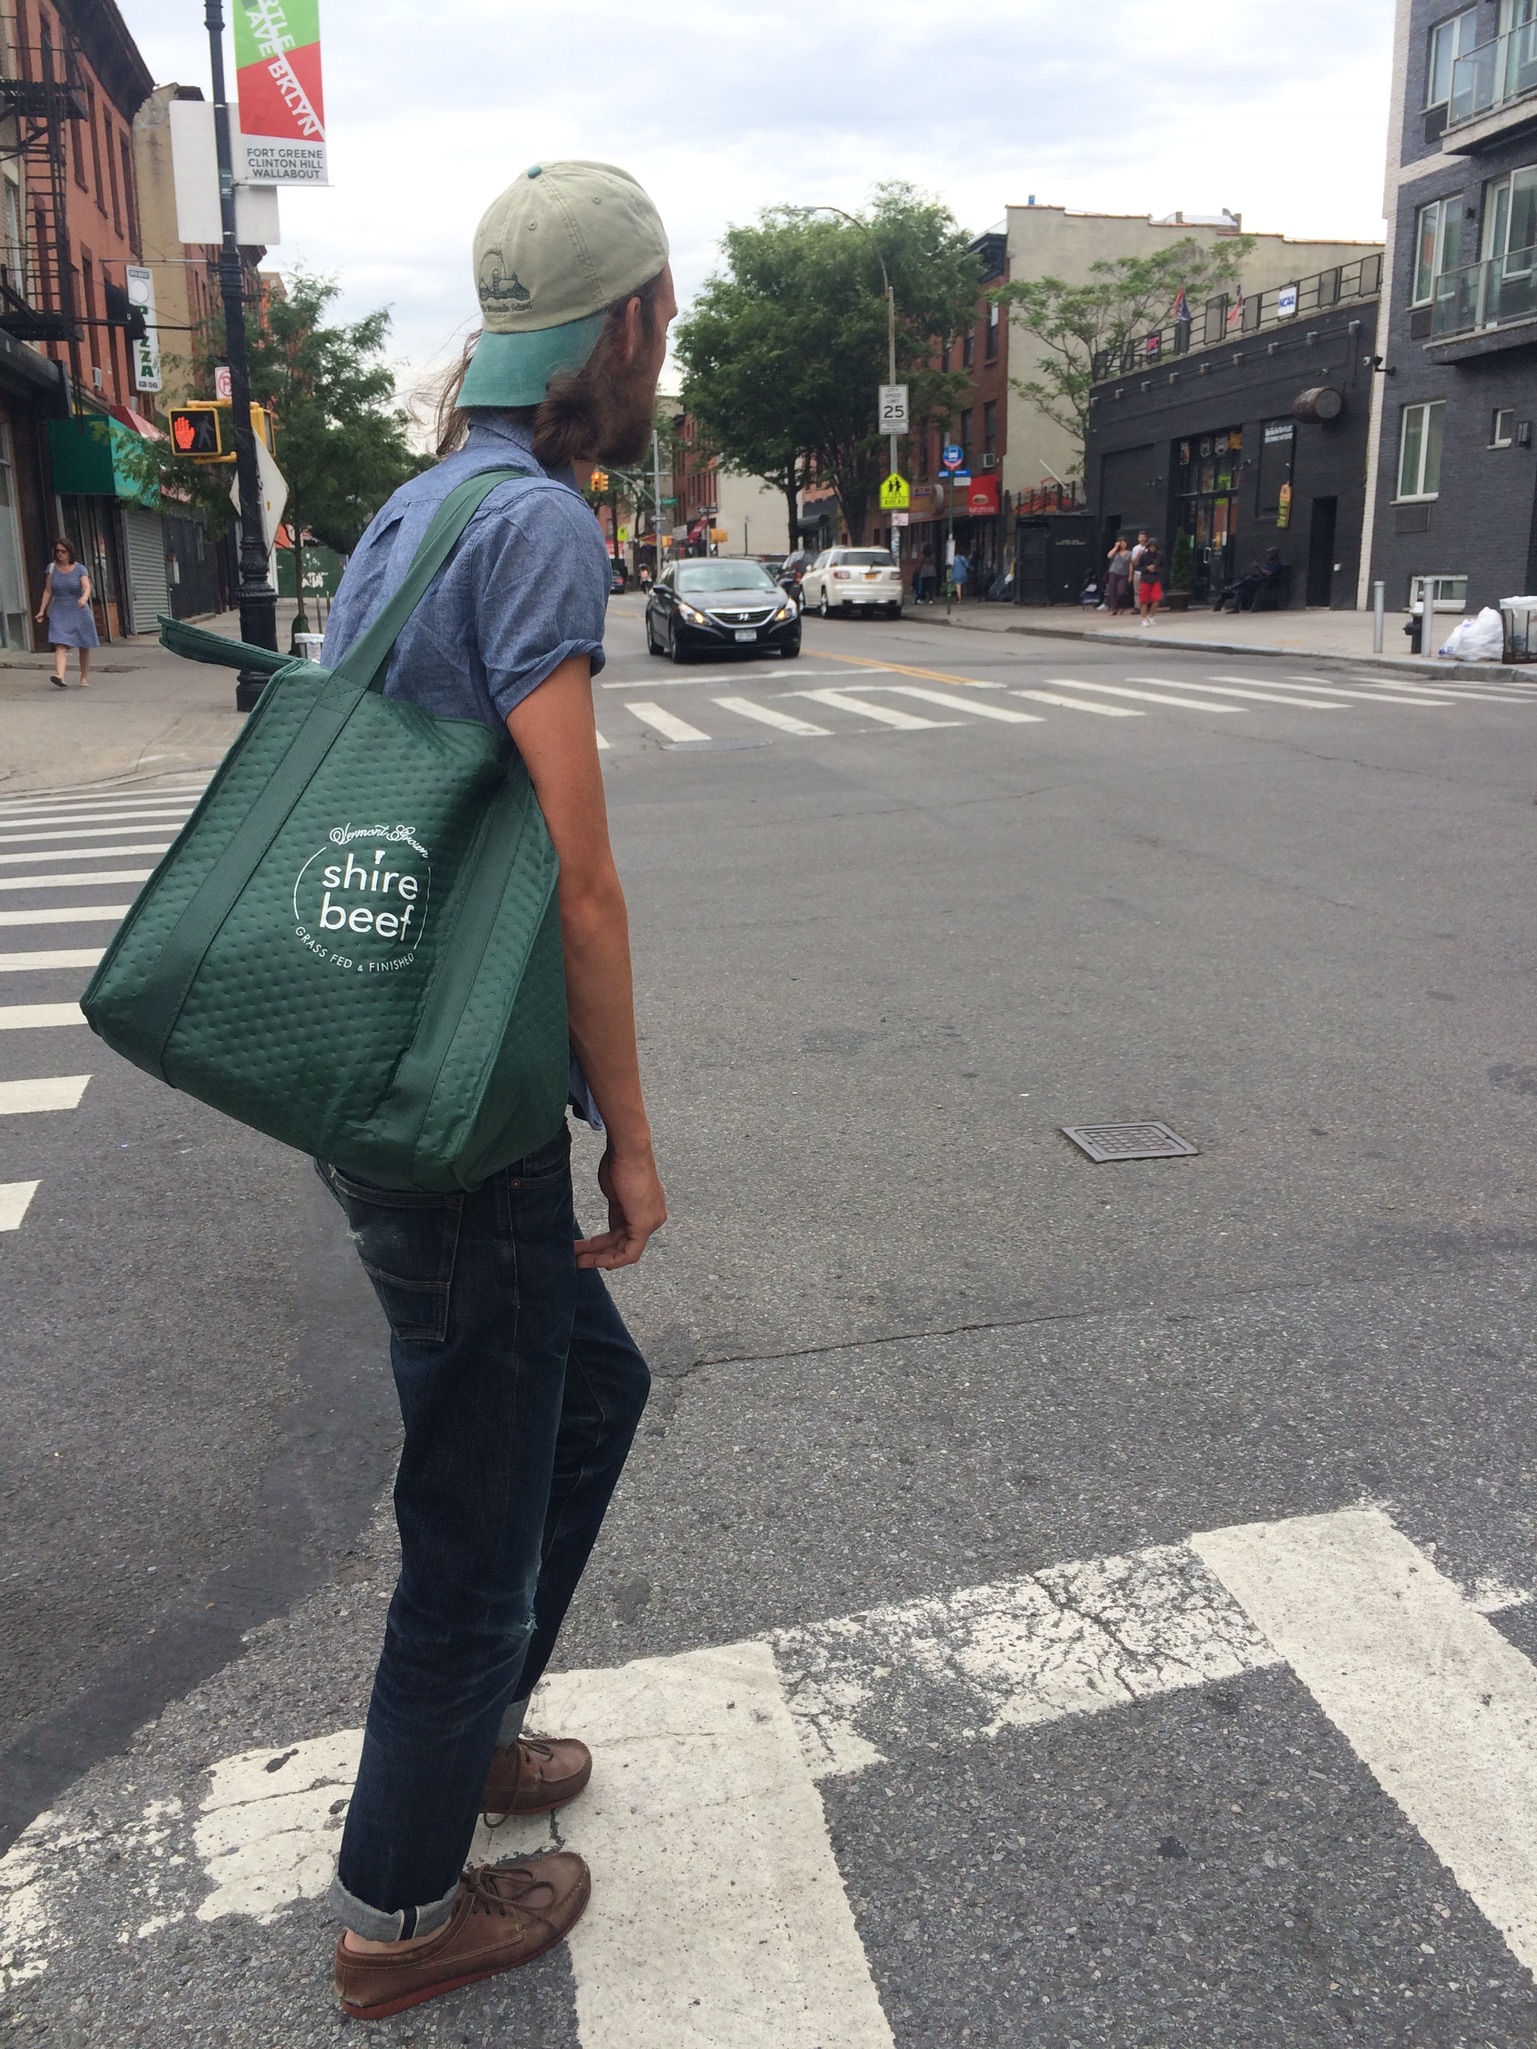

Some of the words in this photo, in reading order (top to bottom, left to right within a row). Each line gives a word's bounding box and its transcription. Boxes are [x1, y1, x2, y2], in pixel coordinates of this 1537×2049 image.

[245, 11, 278, 57] AVE
[267, 59, 319, 137] BKLYN
[246, 148, 275, 158] FORT
[278, 149, 323, 159] GREENE
[248, 158, 297, 169] CLINTON
[300, 160, 323, 169] HILL
[252, 169, 320, 179] WALLABOUT
[136, 305, 154, 378] PZZA
[883, 405, 904, 418] 25
[329, 822, 389, 845] Vermont
[386, 824, 429, 859] Grown
[322, 850, 419, 900] shire
[319, 891, 415, 942] beef
[295, 926, 328, 958] GRASS
[329, 953, 353, 970] FED
[357, 964, 364, 972] &
[369, 952, 415, 972] FINISHED
